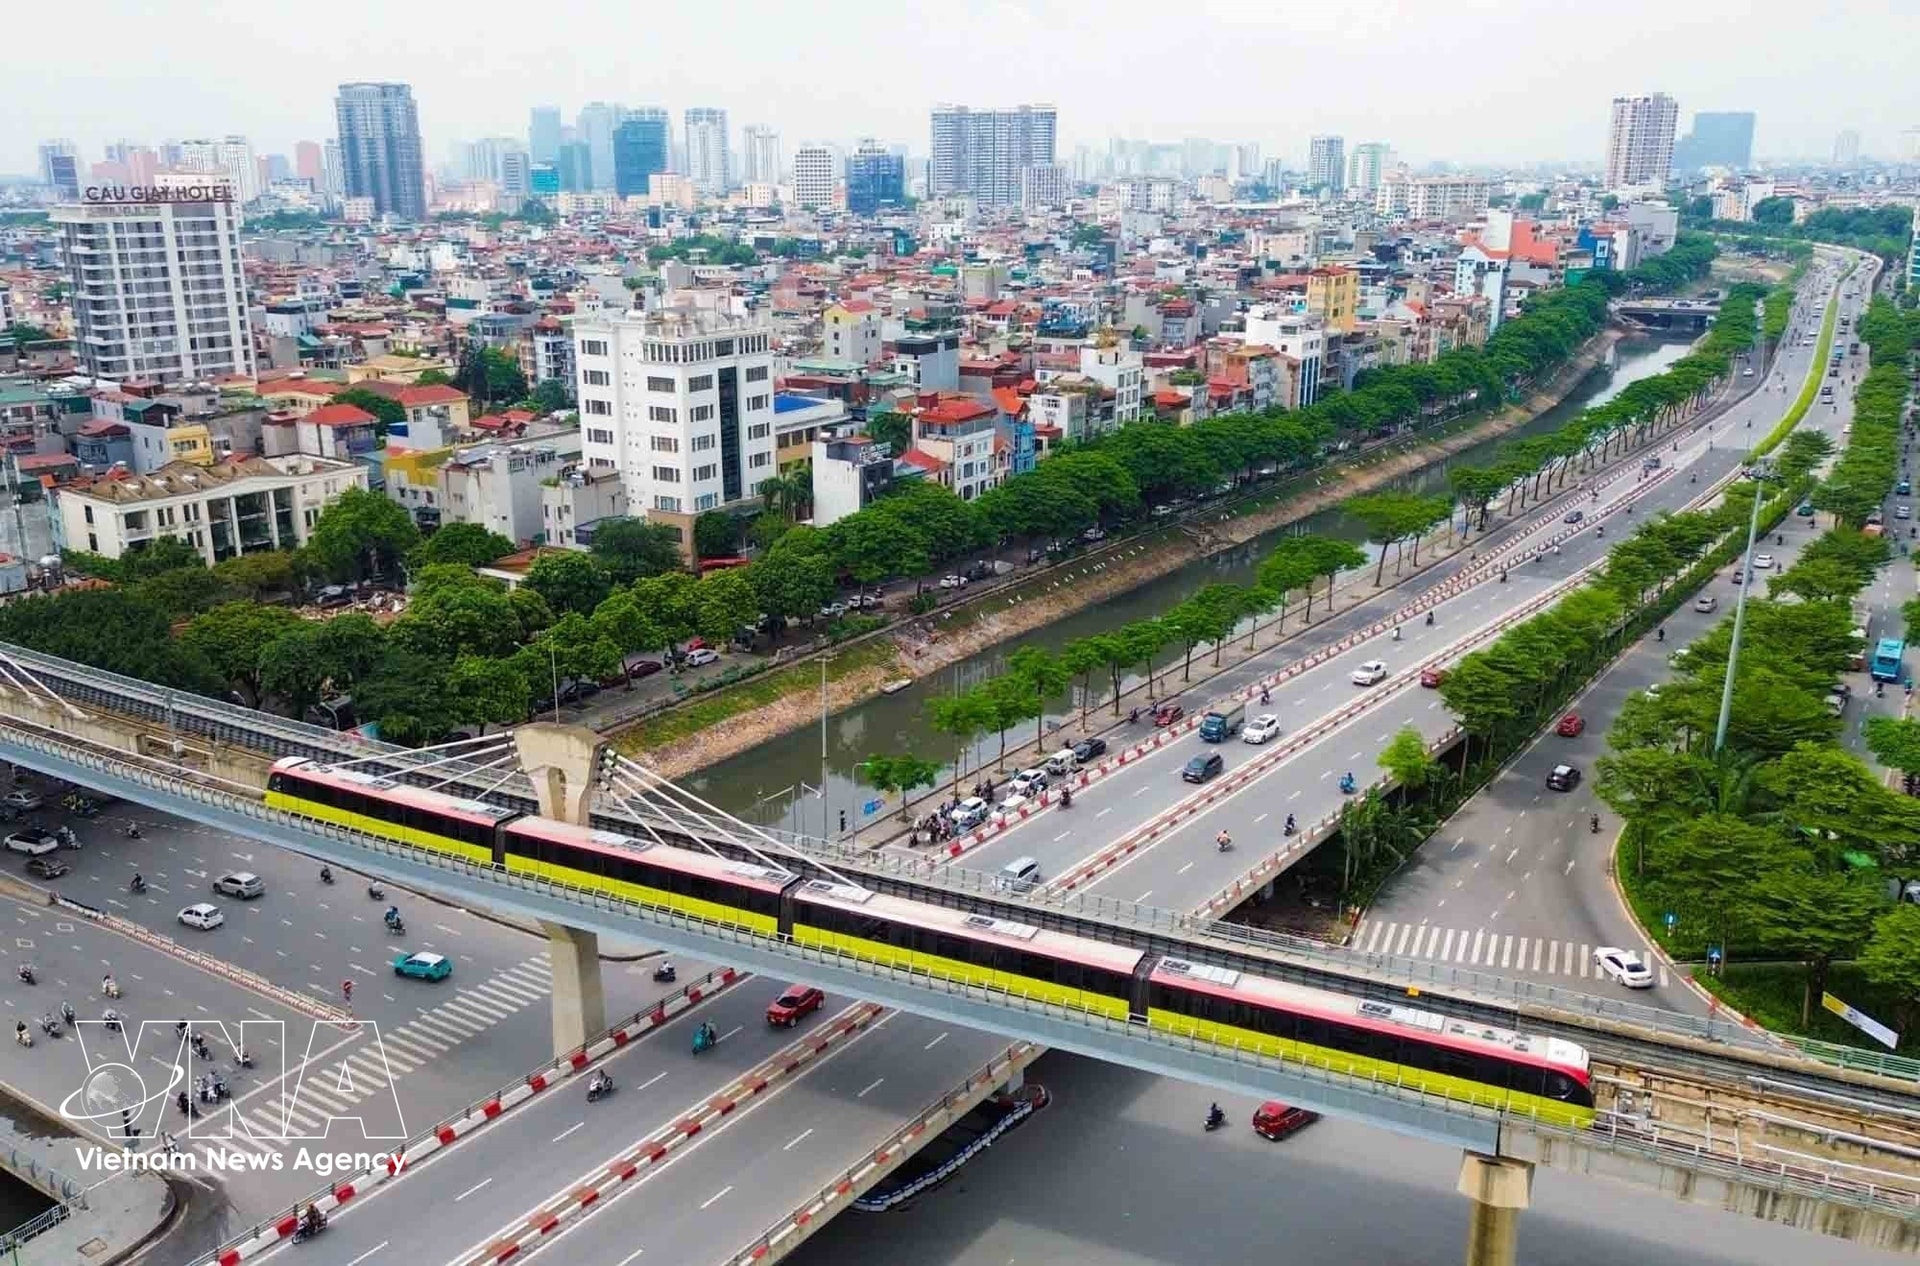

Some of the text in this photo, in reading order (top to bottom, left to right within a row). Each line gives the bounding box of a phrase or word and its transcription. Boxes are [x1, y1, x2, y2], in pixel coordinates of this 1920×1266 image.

[86, 184, 233, 201] CAU GIAY HOTEL
